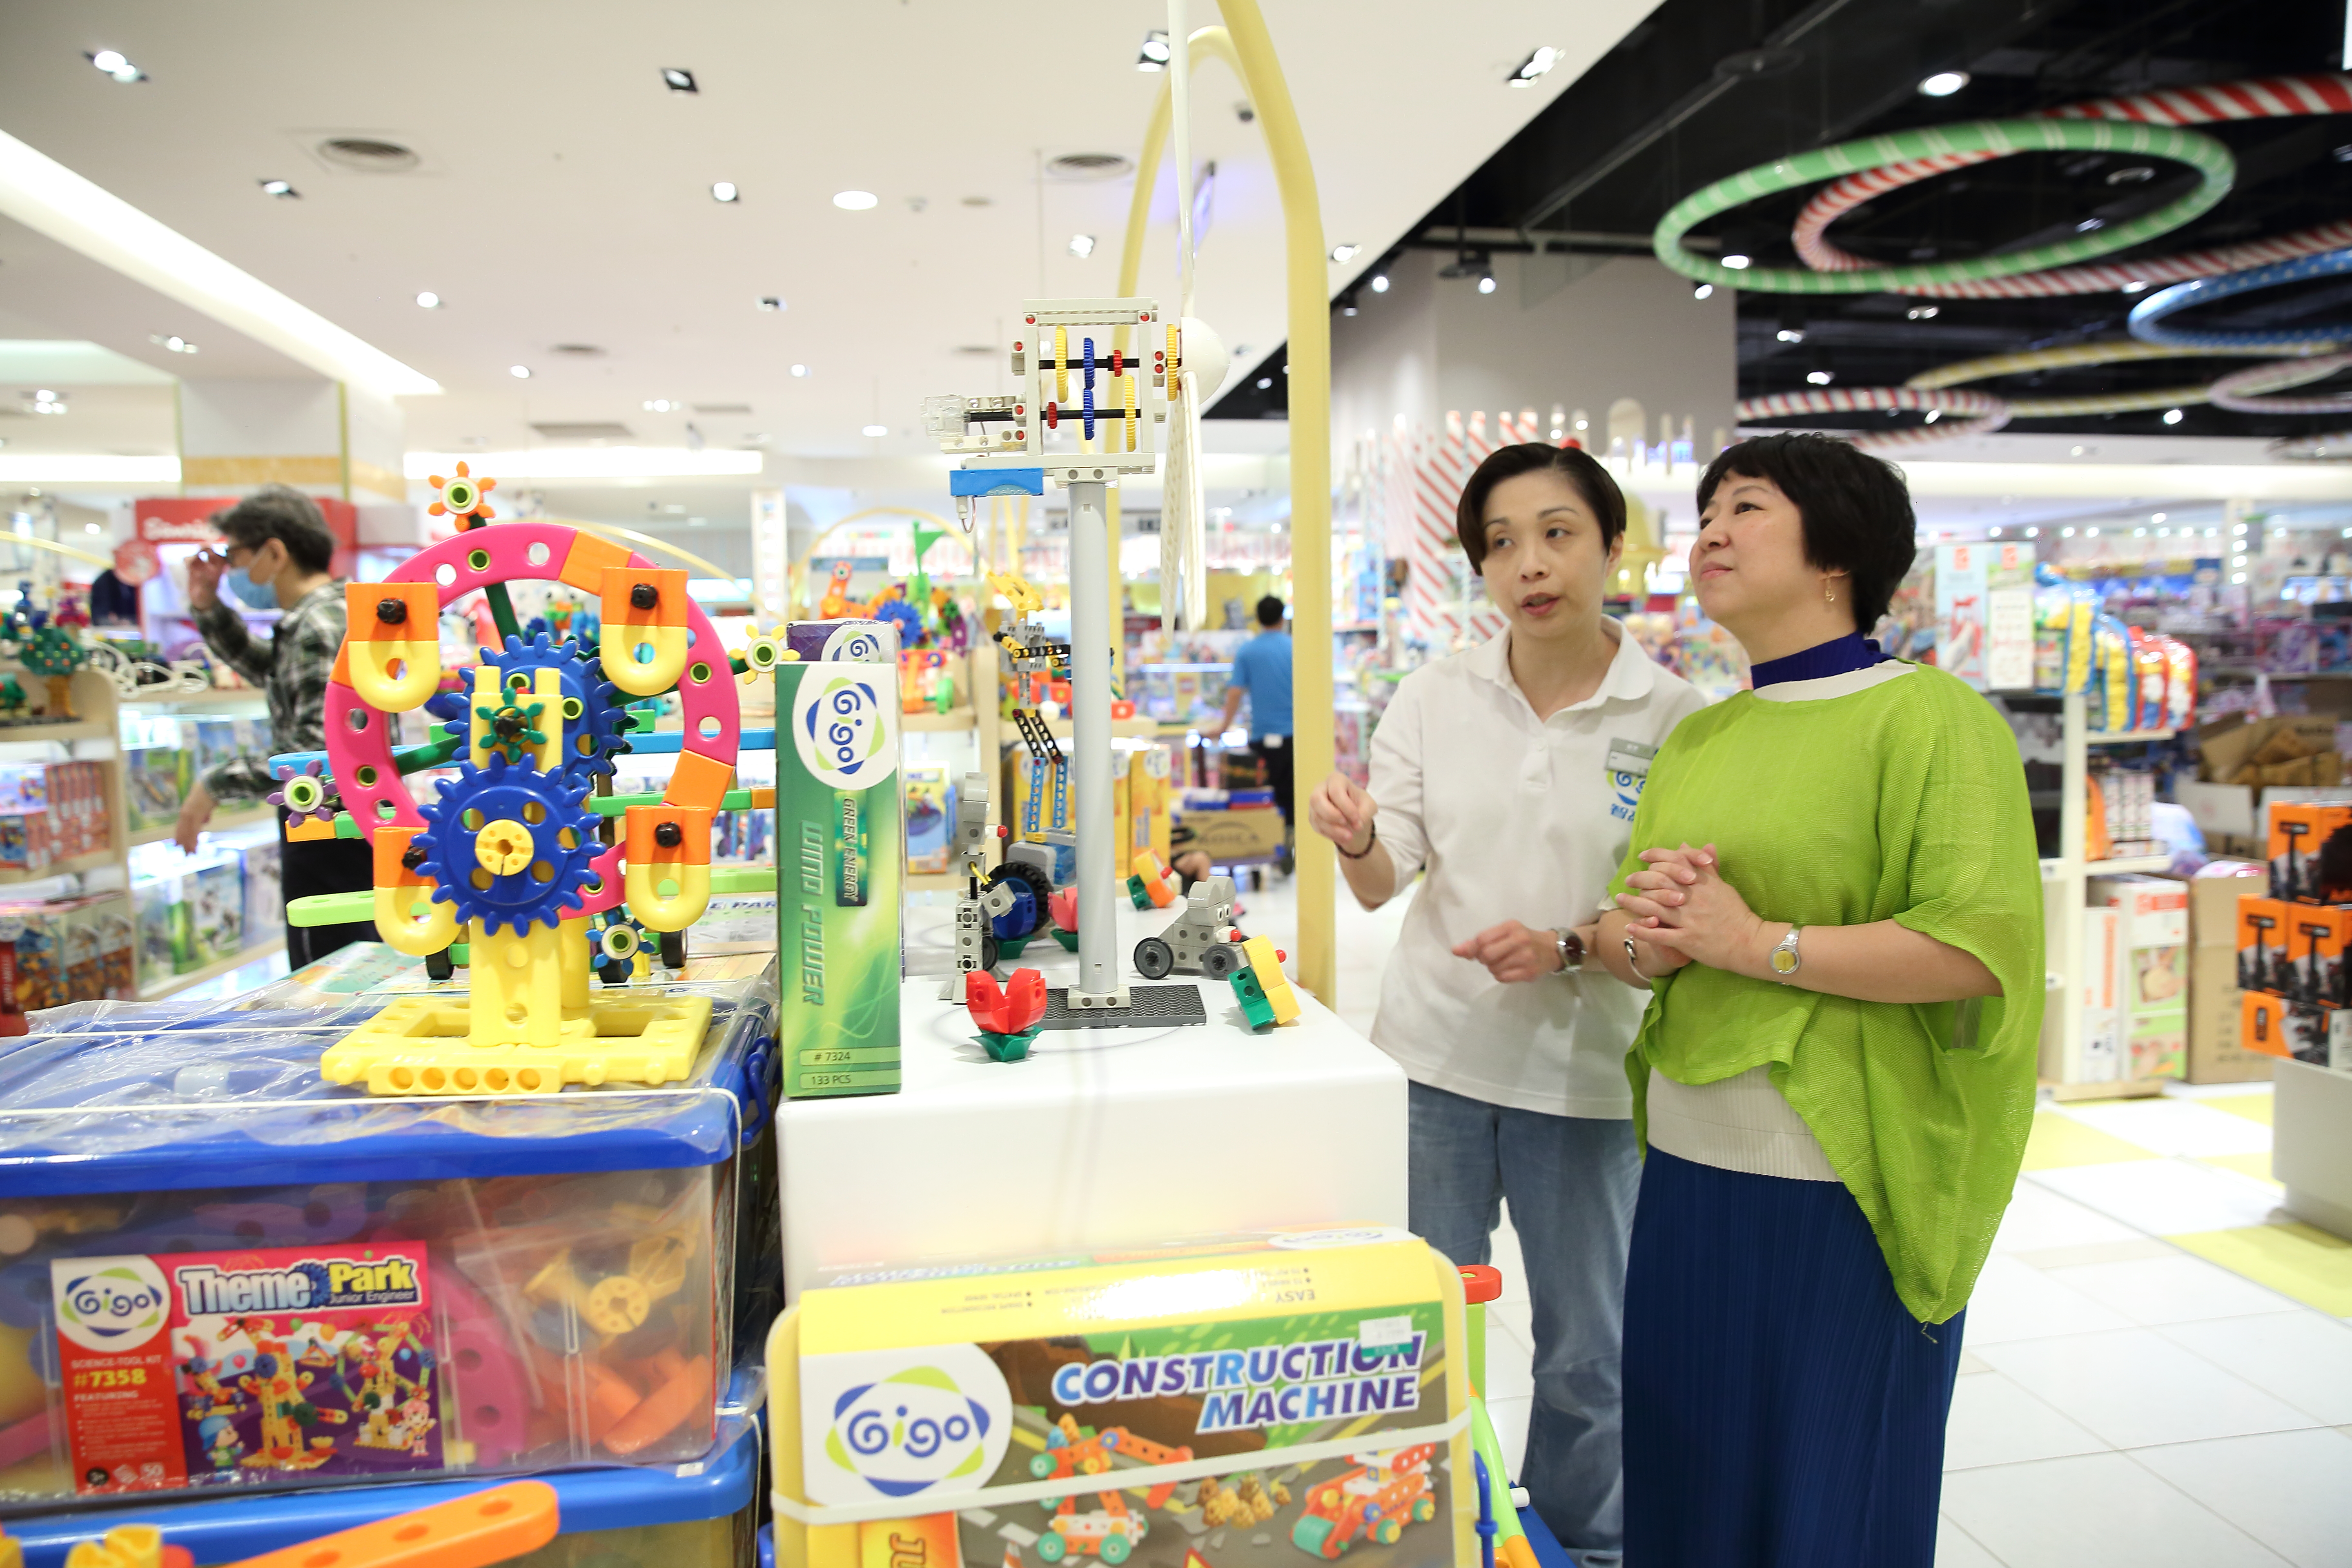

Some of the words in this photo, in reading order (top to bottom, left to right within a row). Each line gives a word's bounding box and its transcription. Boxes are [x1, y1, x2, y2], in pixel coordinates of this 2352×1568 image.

[829, 690, 862, 762] Gigo
[843, 798, 858, 844] GREEN
[801, 820, 824, 896] WIND
[844, 847, 859, 902] ENERGY
[802, 904, 825, 1006] POWER
[812, 1075, 829, 1085] 133
[832, 1074, 851, 1084] PCS
[825, 1051, 851, 1061] 7324
[75, 1288, 150, 1316] Gigo
[181, 1269, 312, 1314] Theme
[328, 1260, 415, 1294] Park
[1276, 1289, 1315, 1303] EASY
[74, 1368, 147, 1388] #7358
[1200, 1376, 1417, 1429] MACHINE
[848, 1405, 970, 1458] Gigo
